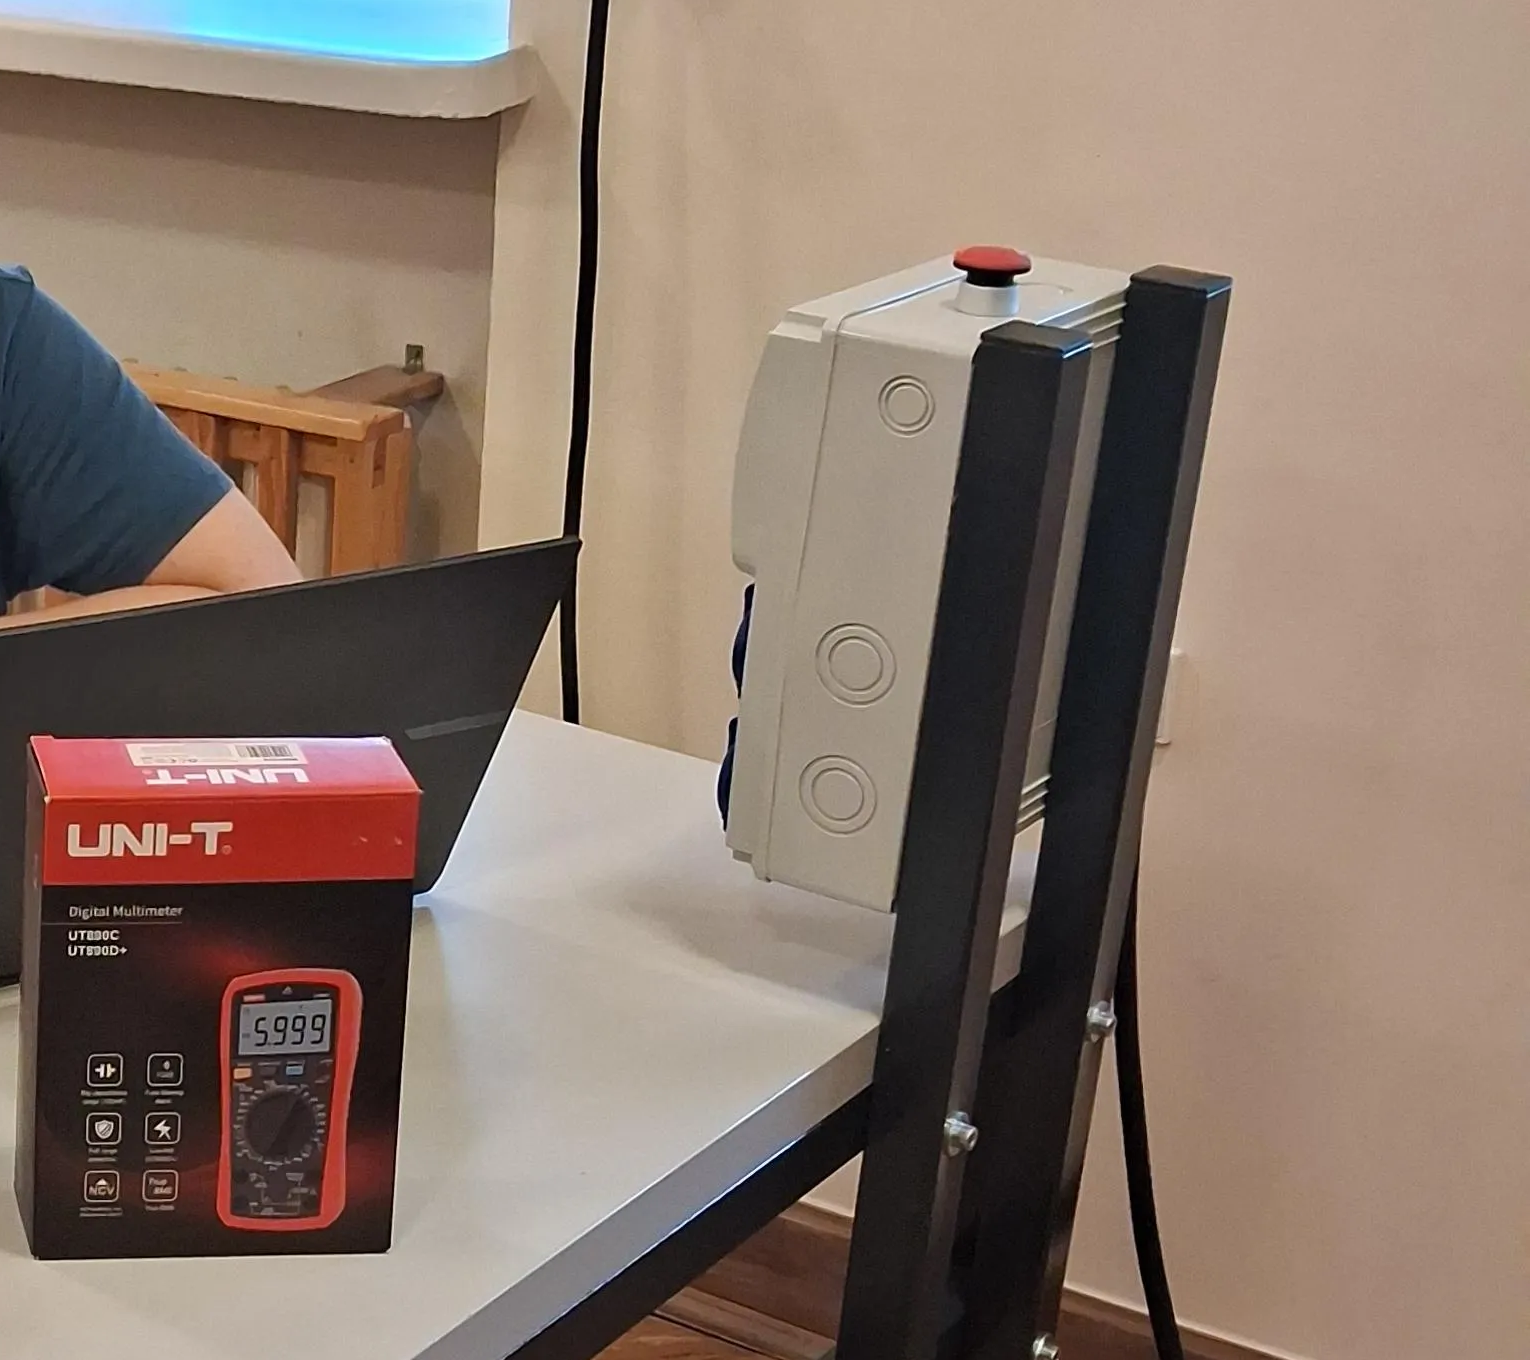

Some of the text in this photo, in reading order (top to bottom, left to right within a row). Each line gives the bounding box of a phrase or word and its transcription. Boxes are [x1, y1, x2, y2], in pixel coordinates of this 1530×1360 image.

[67, 821, 233, 857] UNI-T
[69, 905, 184, 920] Digital Multimeter
